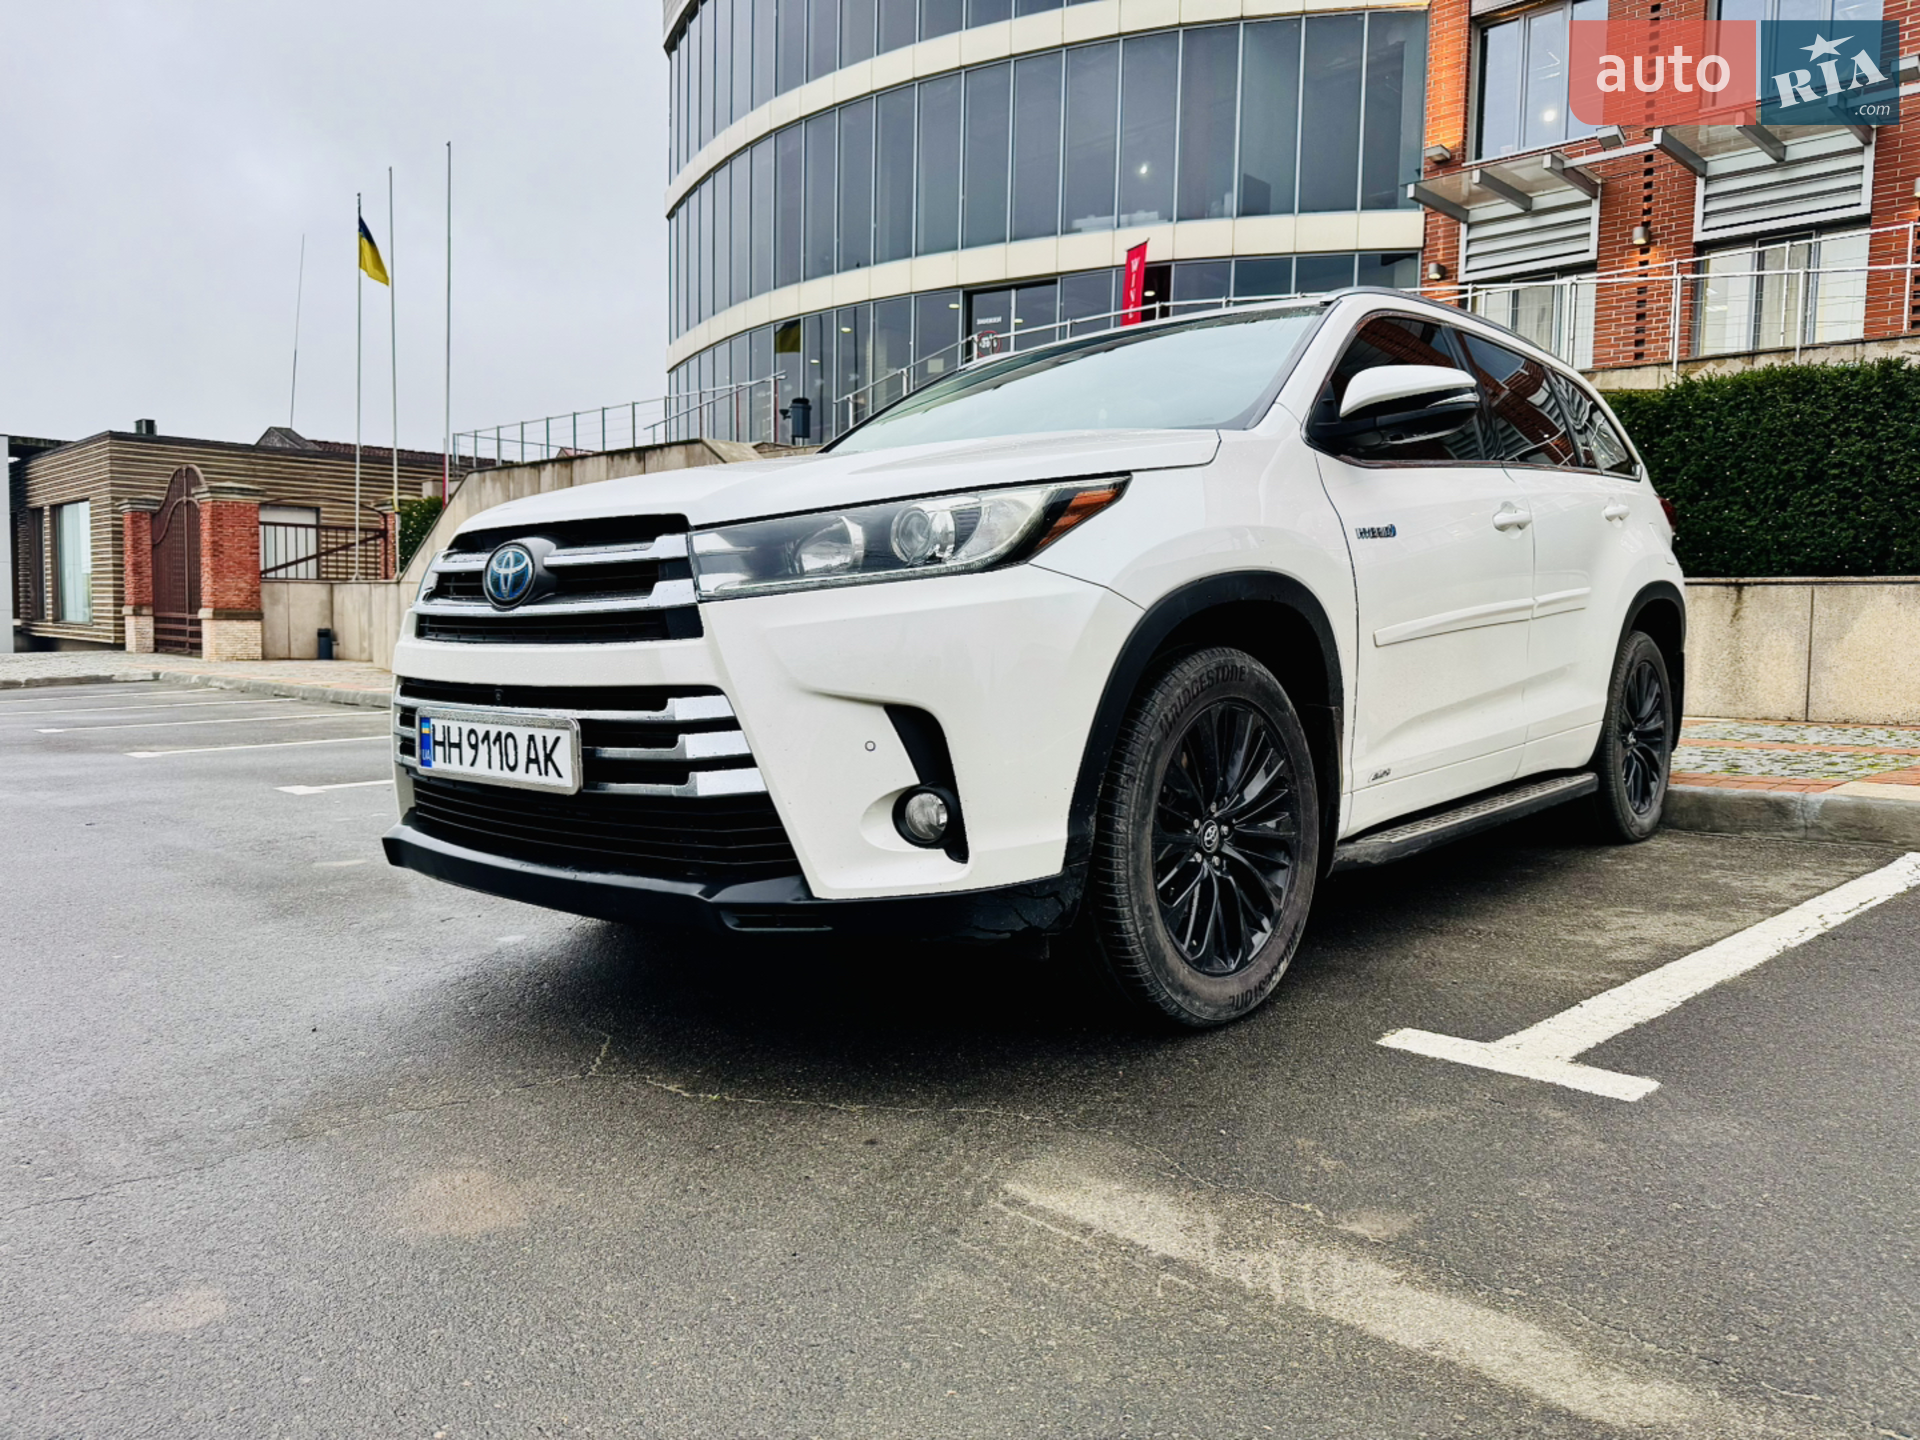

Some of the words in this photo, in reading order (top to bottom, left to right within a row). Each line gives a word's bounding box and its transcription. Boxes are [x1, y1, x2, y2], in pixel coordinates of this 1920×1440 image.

[1159, 664, 1246, 740] BRIDGESTONE
[432, 724, 463, 766] HH
[467, 728, 518, 772] 9110
[525, 733, 563, 778] AK
[1229, 920, 1302, 1010] GESTONE
